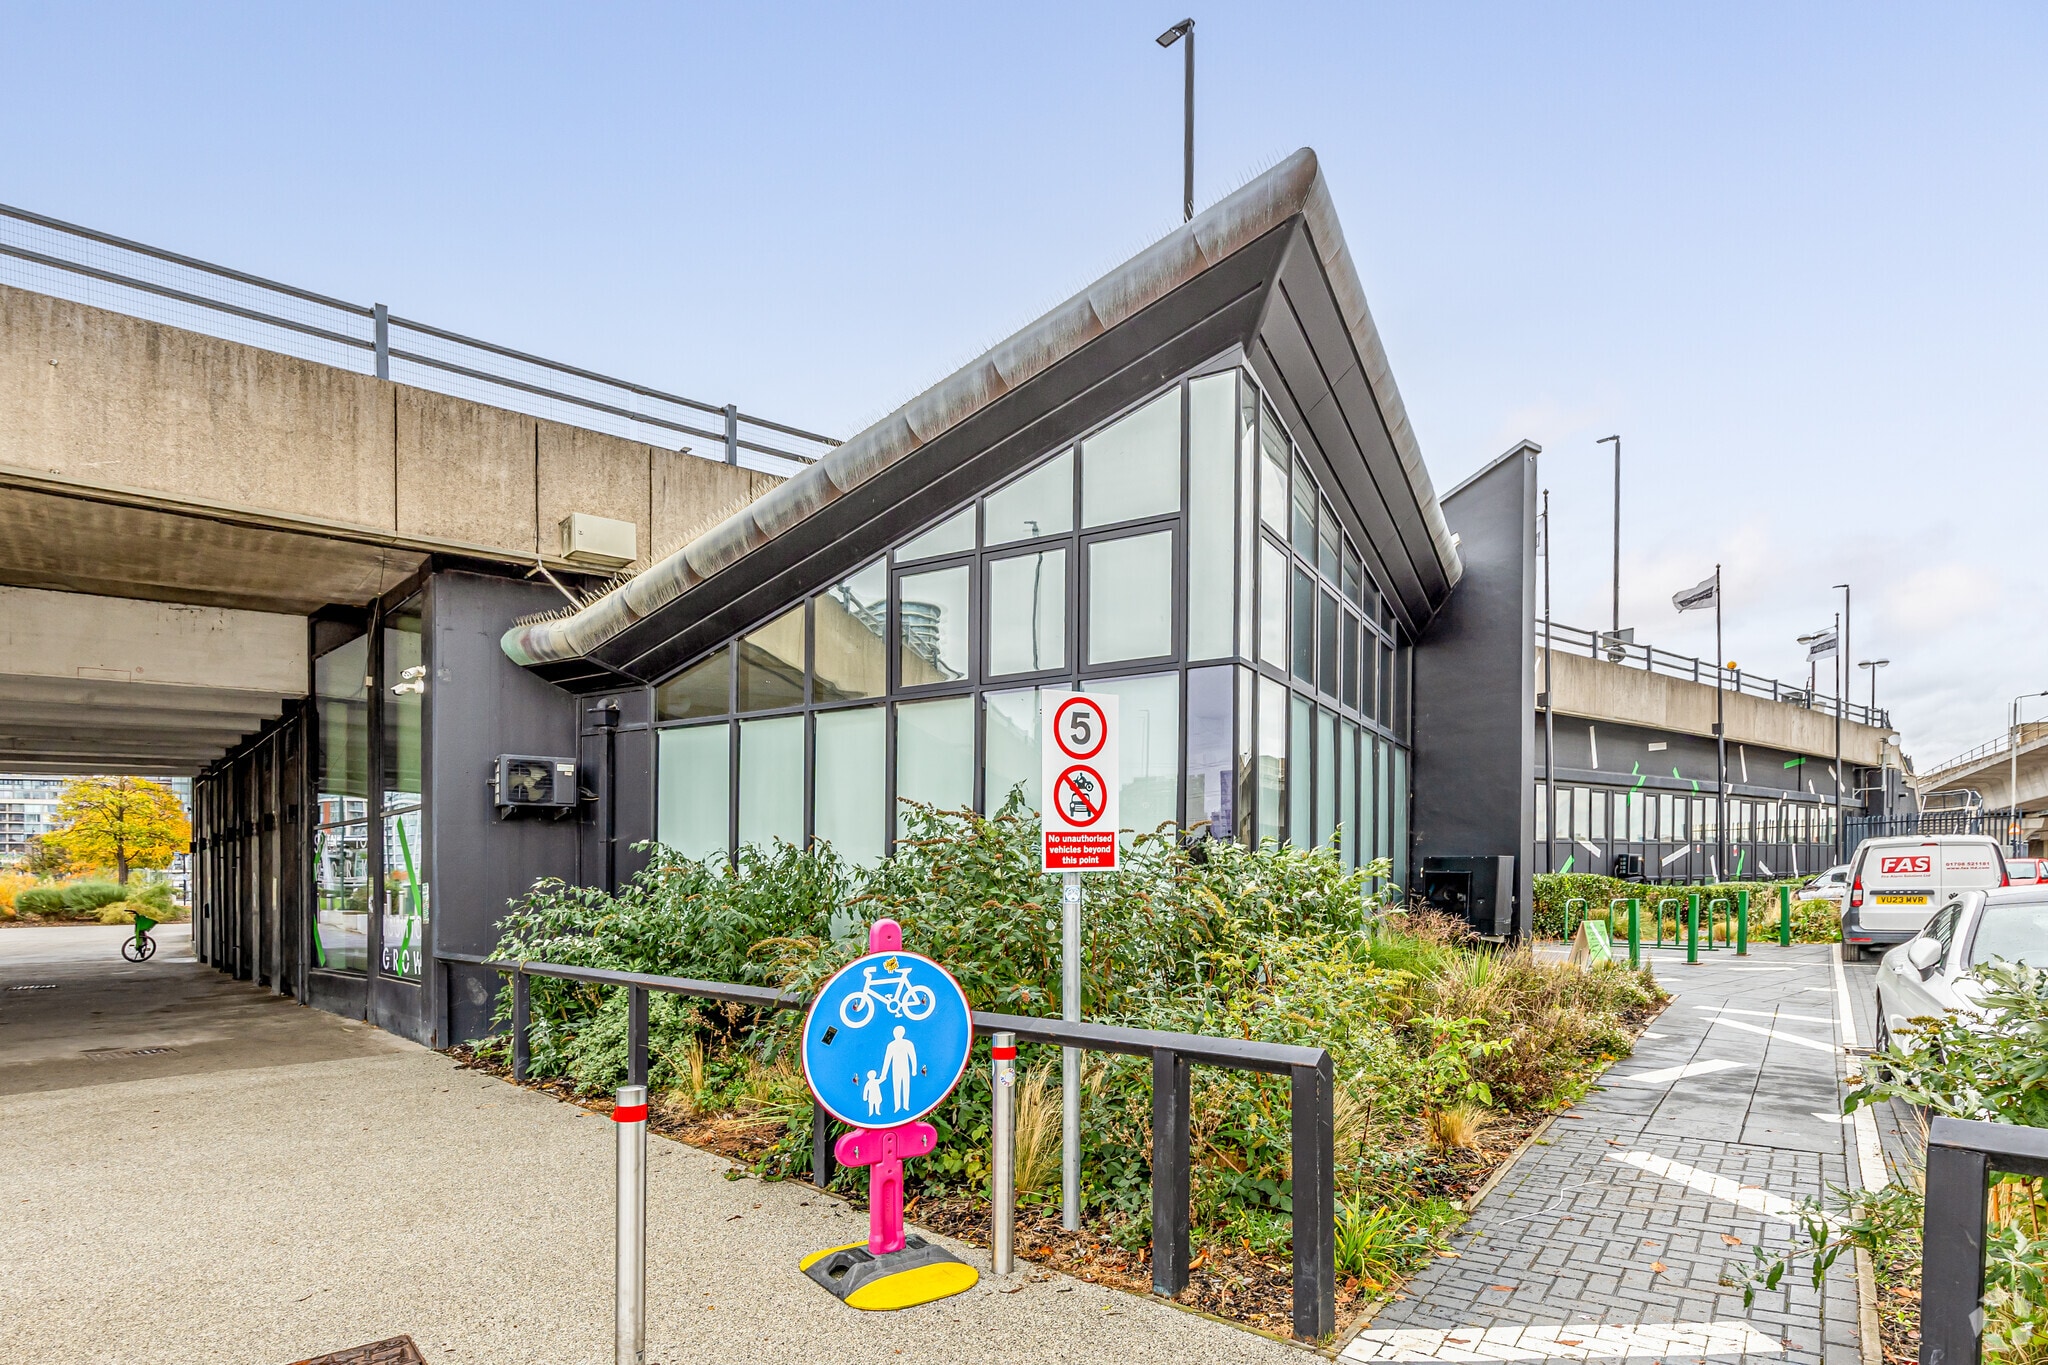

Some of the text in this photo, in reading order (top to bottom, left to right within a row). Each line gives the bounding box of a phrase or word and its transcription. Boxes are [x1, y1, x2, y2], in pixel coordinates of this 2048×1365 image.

[1070, 711, 1091, 745] 5
[1048, 834, 1113, 843] No unauthorised
[1049, 845, 1111, 855] vehicles beyond
[1062, 856, 1100, 866] this point
[1882, 857, 1930, 873] FAS
[382, 947, 422, 975] GROW
